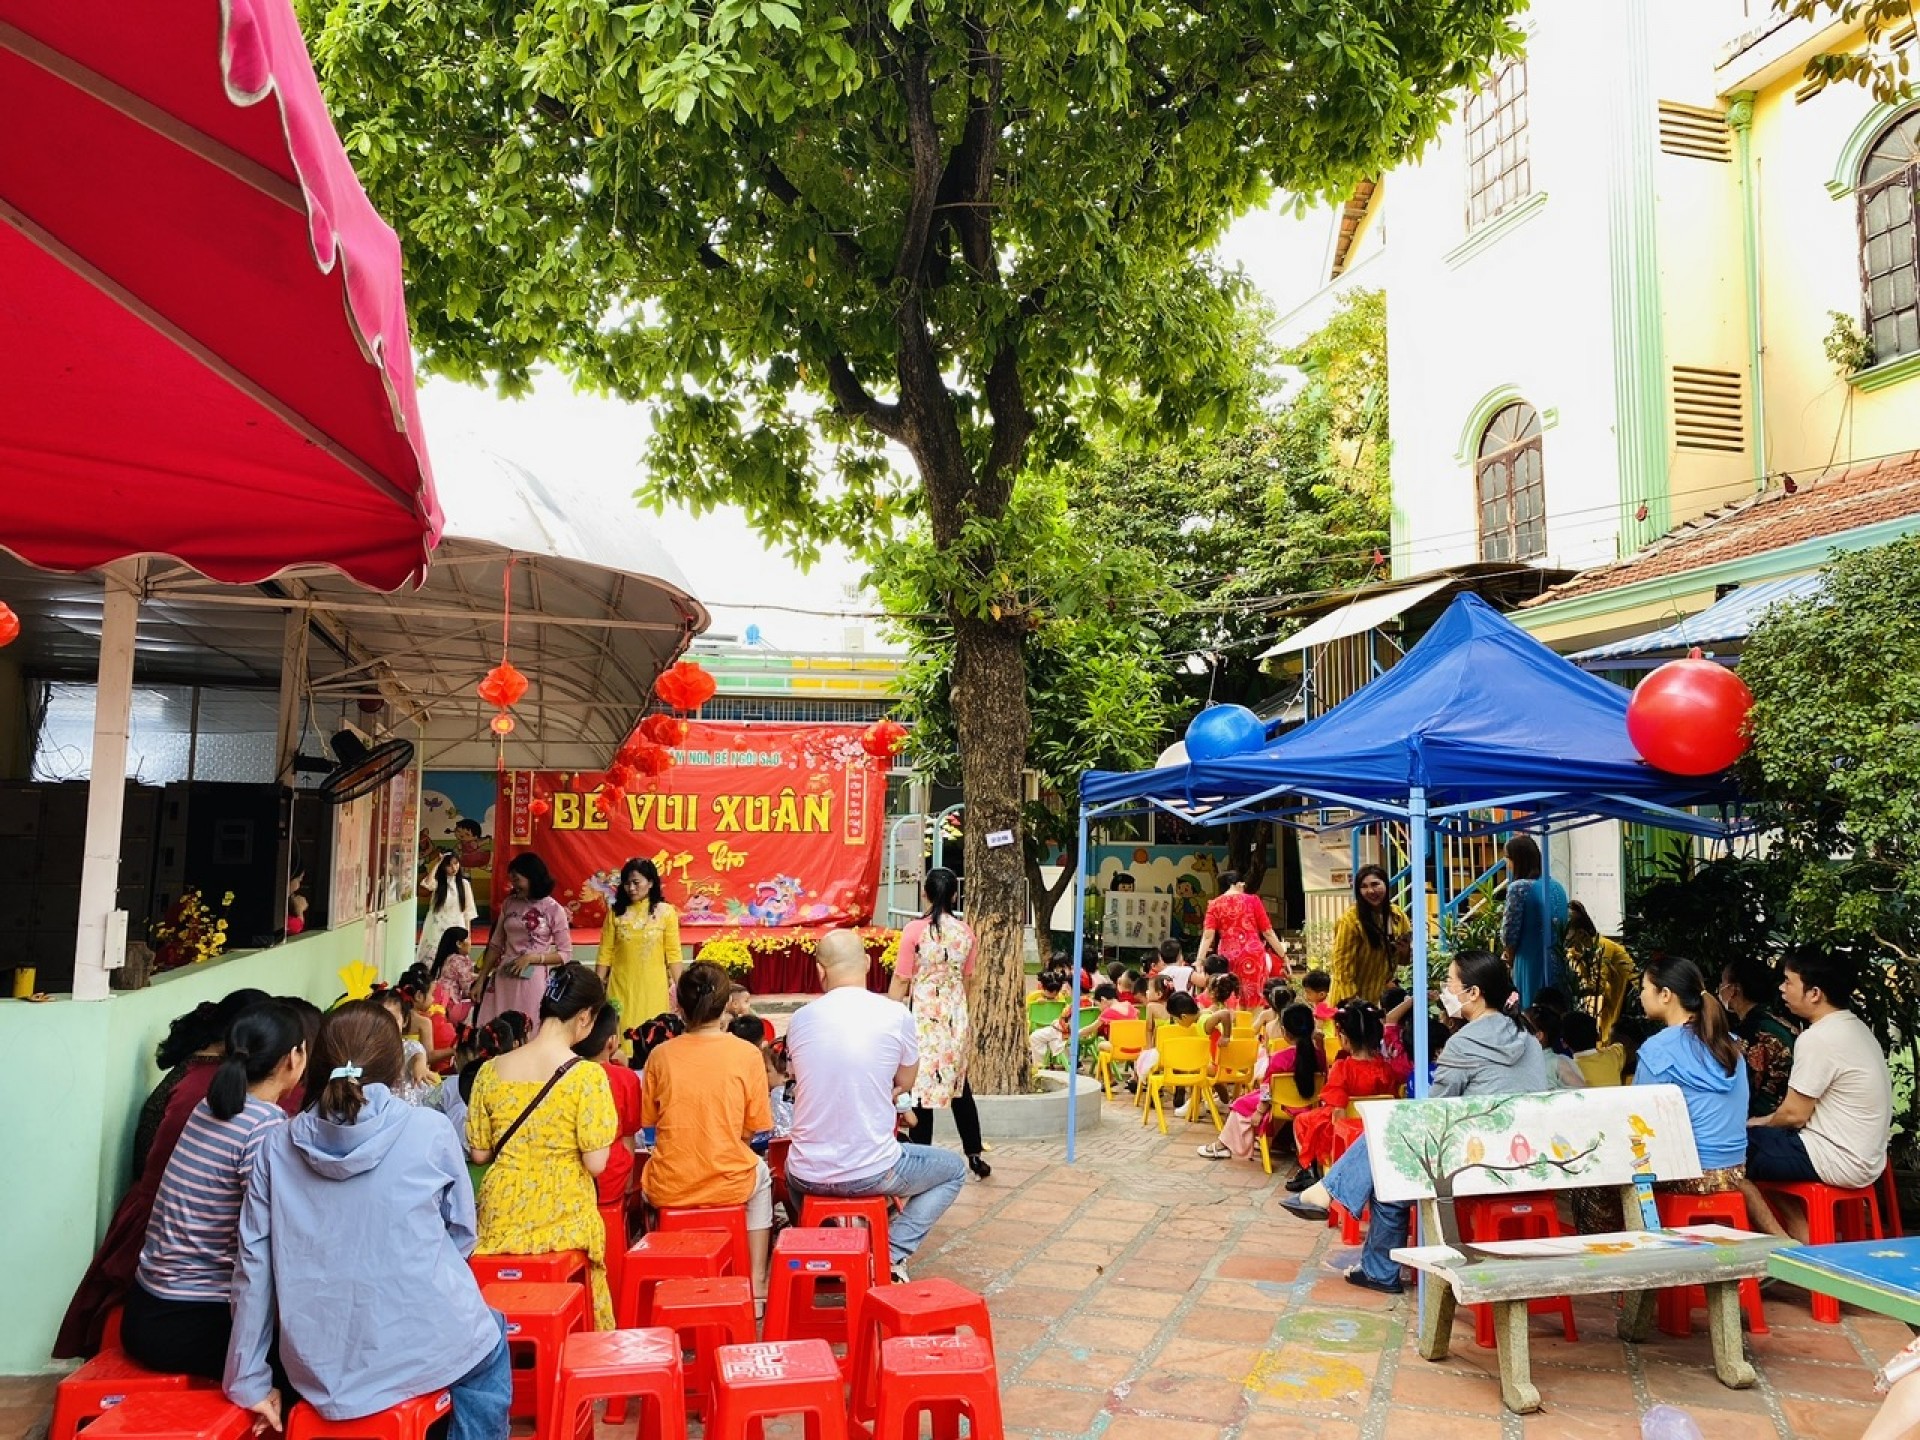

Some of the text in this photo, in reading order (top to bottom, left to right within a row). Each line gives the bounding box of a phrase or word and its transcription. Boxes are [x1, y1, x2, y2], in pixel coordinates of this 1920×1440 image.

[714, 748, 728, 765] BÉ
[551, 782, 609, 831] BÉ
[626, 794, 700, 832] VUI
[712, 787, 833, 832] XUÂN
